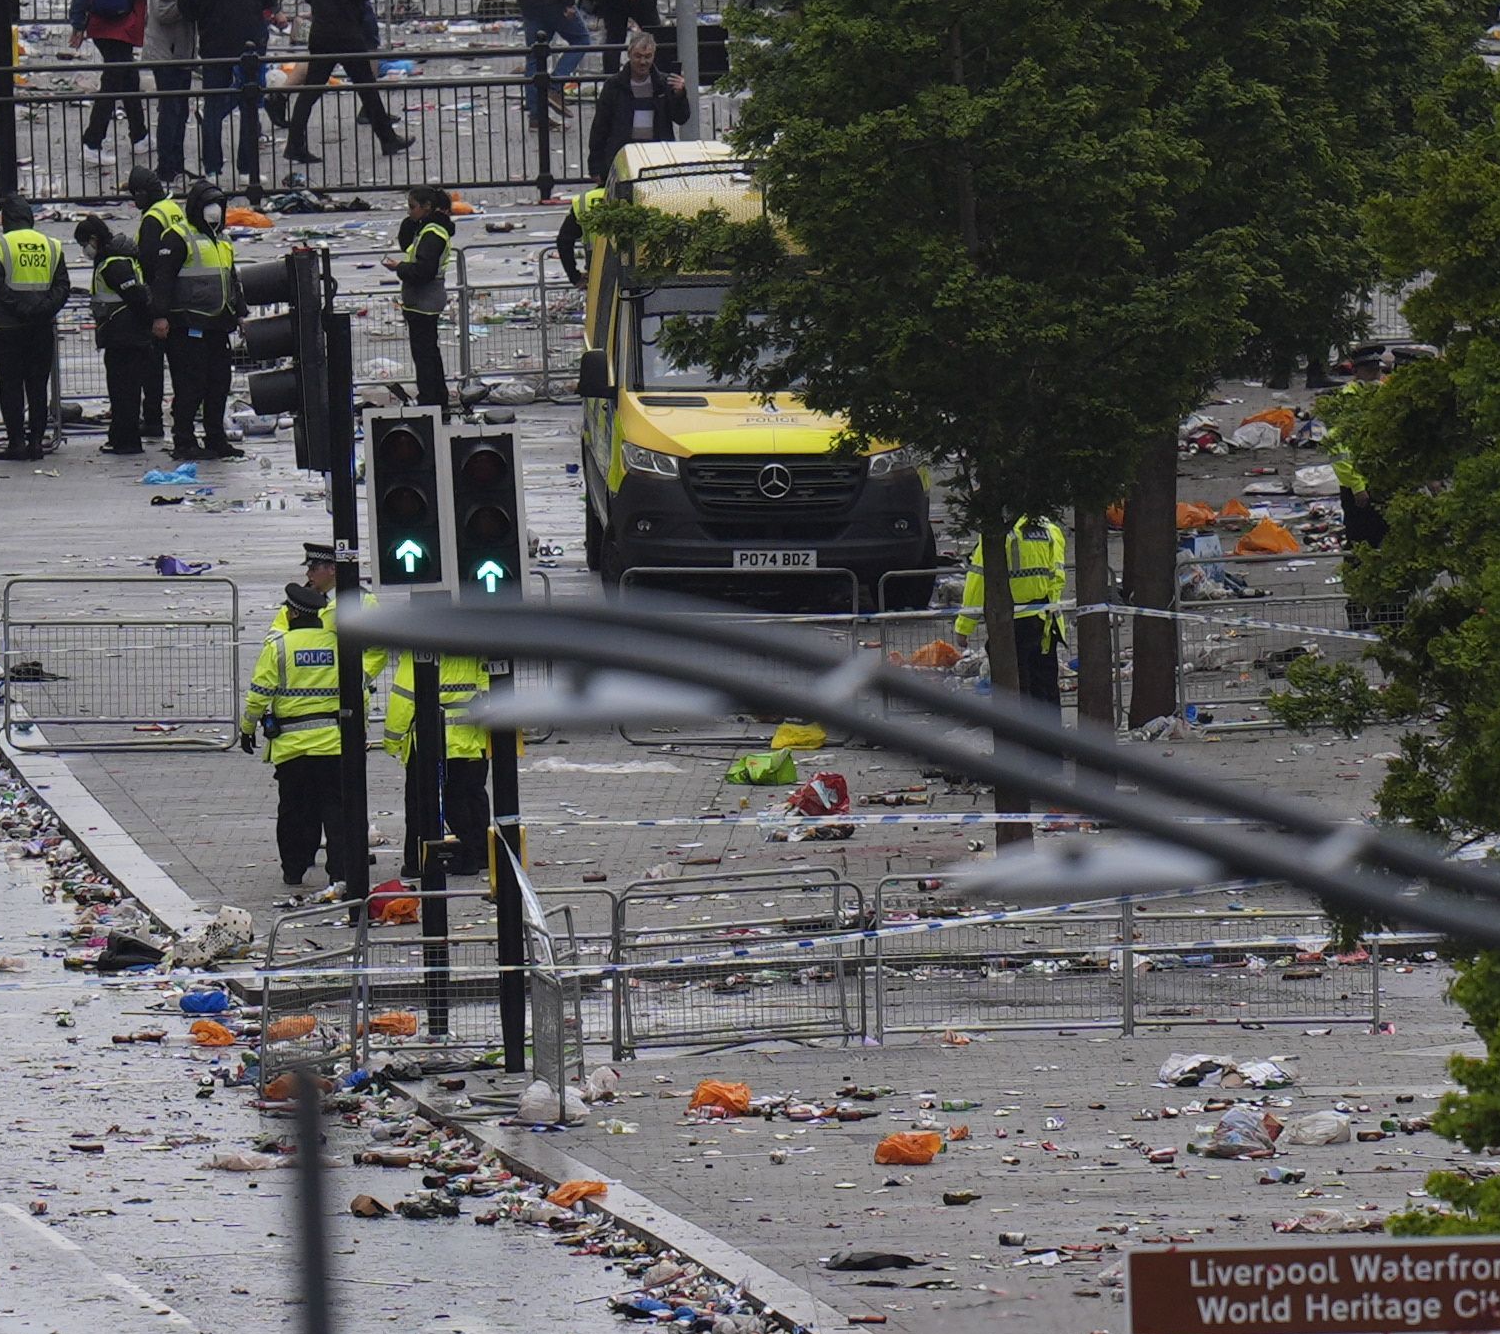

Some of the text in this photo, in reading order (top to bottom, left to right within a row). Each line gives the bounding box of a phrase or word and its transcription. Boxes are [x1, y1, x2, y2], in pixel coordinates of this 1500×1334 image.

[19, 254, 47, 268] GV82
[746, 415, 800, 424] POLICE
[740, 552, 810, 565] PO74 BDZ
[296, 651, 334, 665] POLICE
[1190, 1257, 1340, 1289] Liverpool
[1197, 1295, 1291, 1325] World
[1306, 1293, 1442, 1326] Heritage
